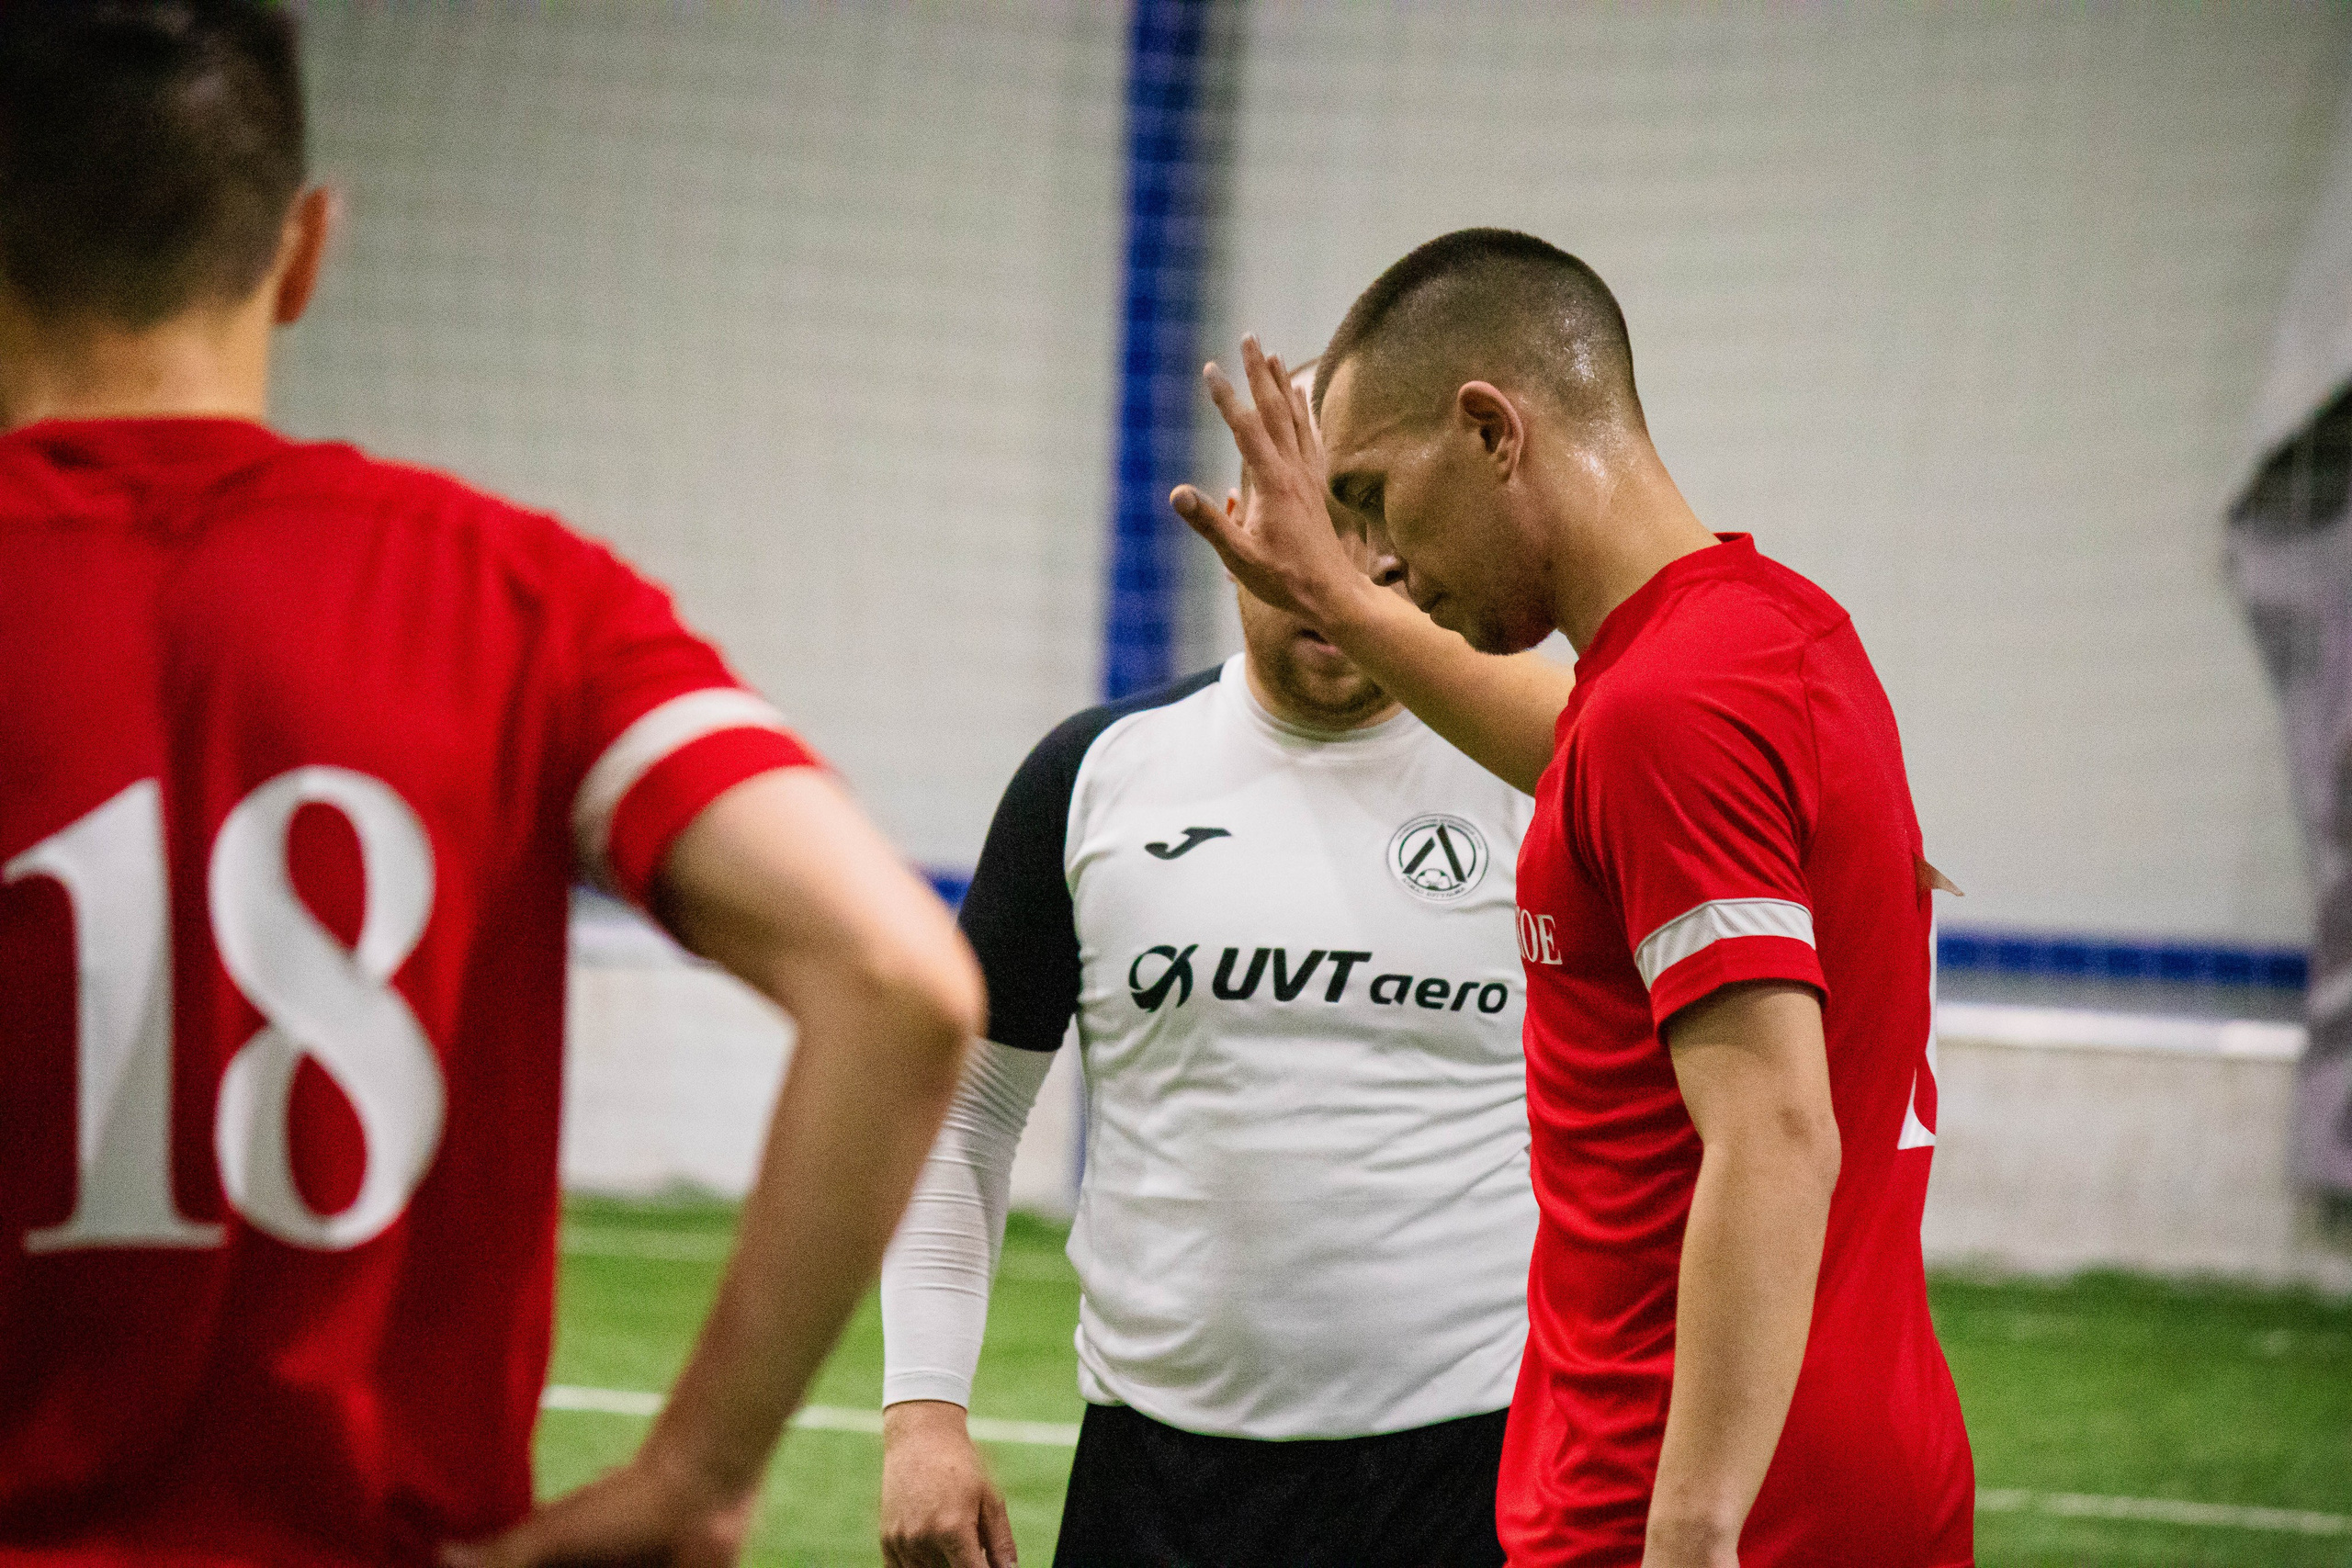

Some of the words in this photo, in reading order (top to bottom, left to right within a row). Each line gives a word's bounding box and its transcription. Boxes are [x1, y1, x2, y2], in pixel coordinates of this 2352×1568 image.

[1515, 906, 1563, 965] OE
[2, 764, 449, 1255] 18
[1212, 947, 1372, 1003] UVT
[1370, 974, 1509, 1013] aero
